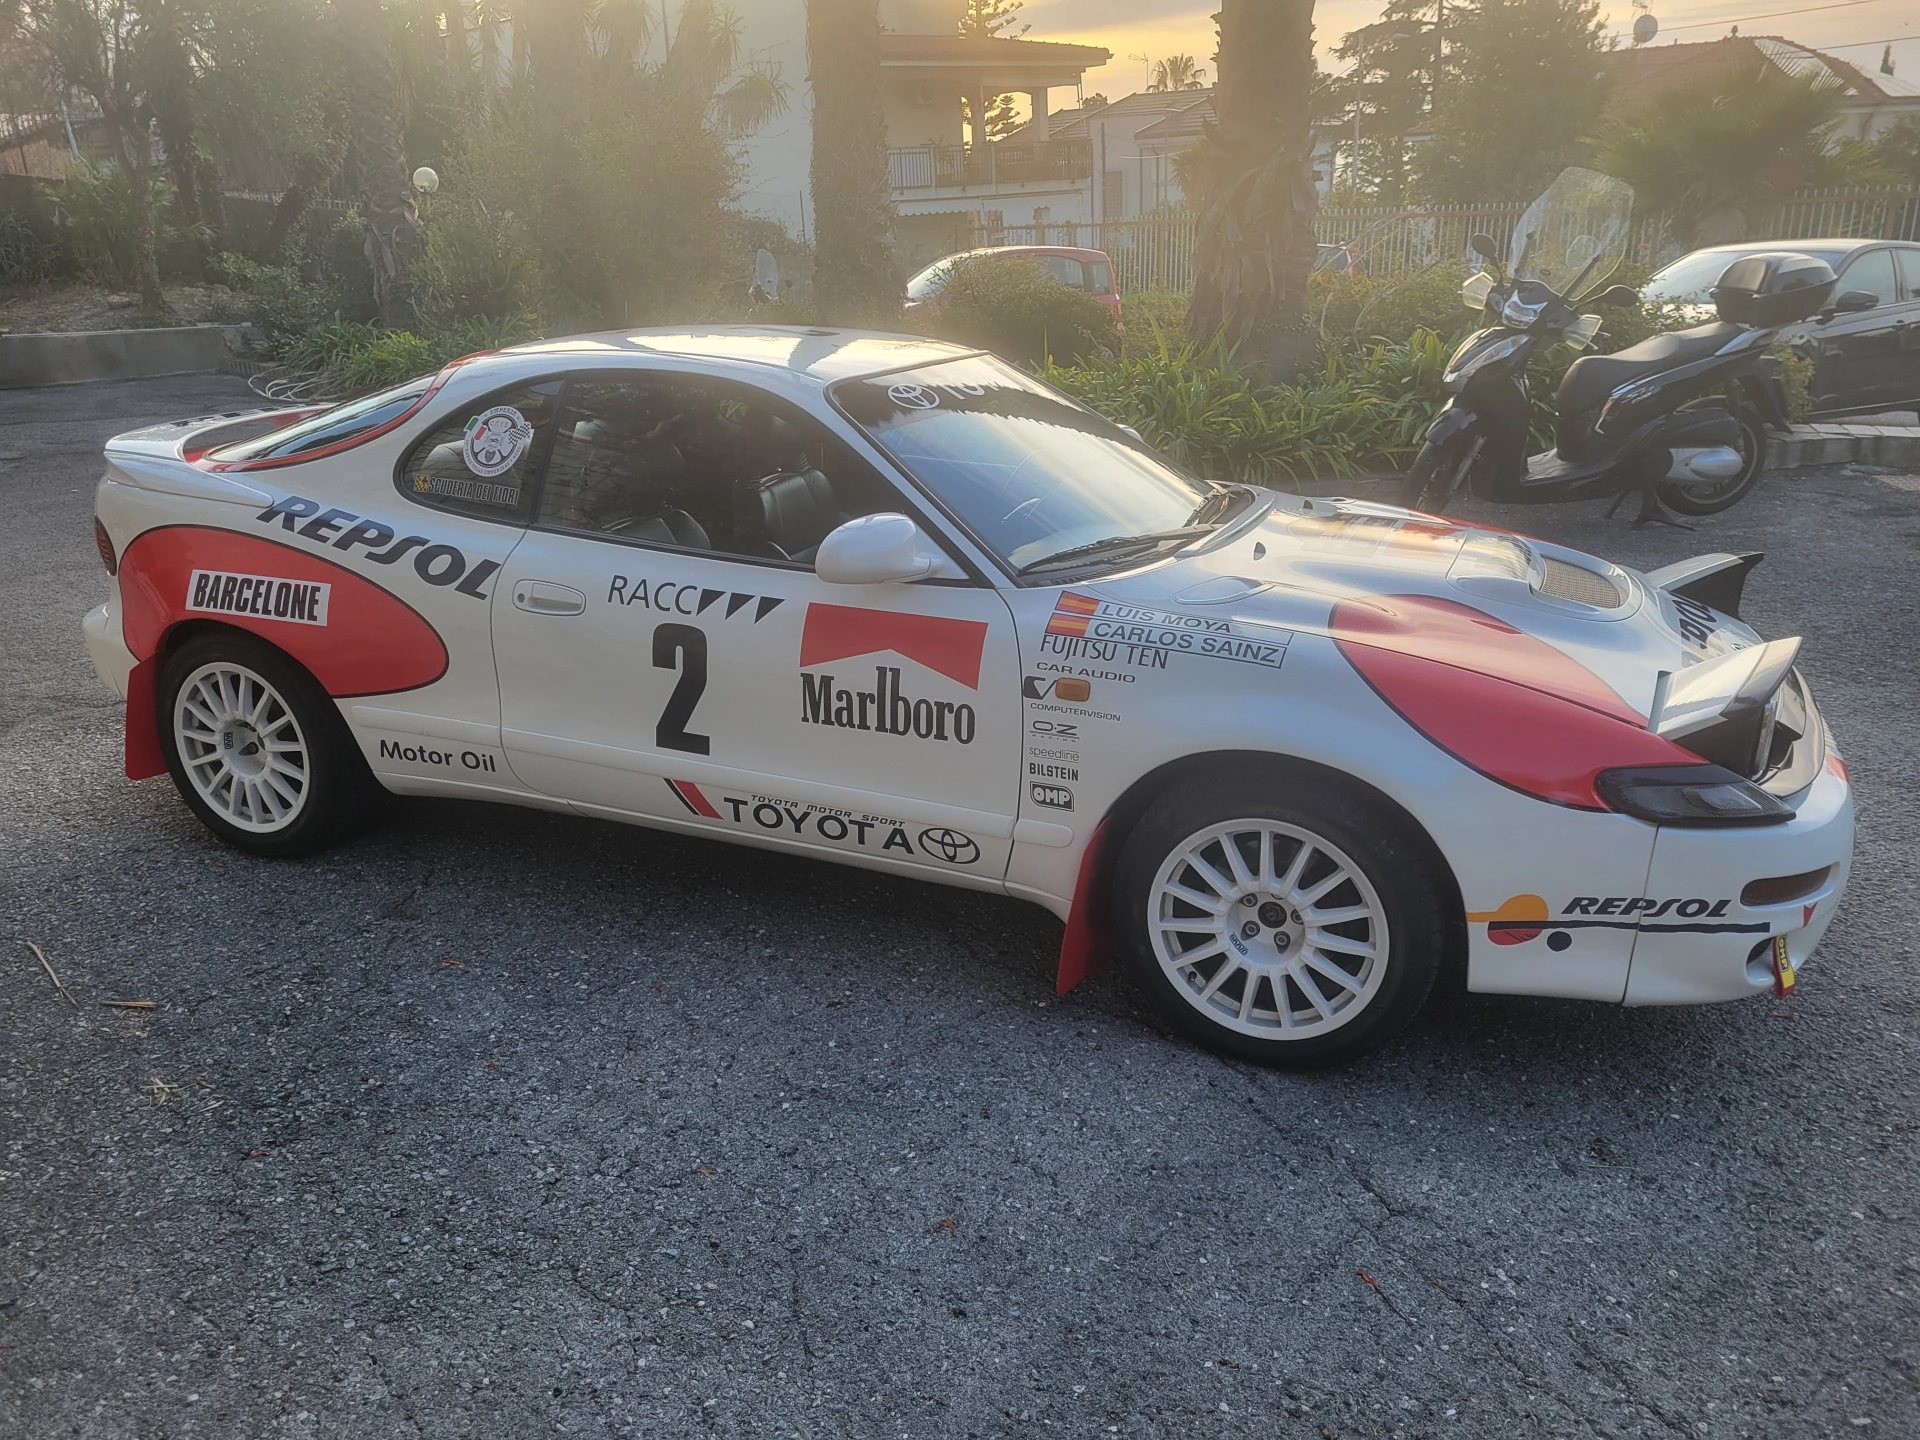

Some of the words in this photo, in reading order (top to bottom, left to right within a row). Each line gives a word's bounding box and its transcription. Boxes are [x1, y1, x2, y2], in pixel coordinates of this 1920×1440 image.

[429, 477, 473, 498] SCUDERIA
[475, 484, 493, 501] DEI
[492, 486, 520, 505] FIORI
[256, 495, 501, 601] REPSOL
[193, 573, 321, 622] BARCELONE
[608, 574, 699, 617] RACC
[1101, 604, 1154, 623] LUIS
[1161, 615, 1231, 634] MOYA
[1040, 634, 1119, 662] FUJITSU
[1126, 645, 1170, 670] TEN
[1094, 622, 1194, 650] CARLOS
[1200, 638, 1280, 664] SAINZ
[652, 623, 711, 757] 2
[1036, 662, 1074, 675] CAR
[1078, 668, 1136, 684] AUDIO
[800, 666, 975, 745] Marlboro
[1030, 702, 1121, 722] COMPUTERVISION
[379, 739, 454, 766] Motor
[461, 749, 497, 773] Oil
[1029, 747, 1079, 762] speedline
[1029, 762, 1079, 782] BILSTEIN
[751, 794, 798, 809] TOYOTA
[806, 804, 852, 819] MOTOR
[860, 815, 906, 828] SPORT
[1033, 786, 1071, 806] OMP
[723, 796, 915, 856] TOYOTA
[1561, 896, 1732, 919] REPSOL
[1778, 938, 1788, 969] OMP
